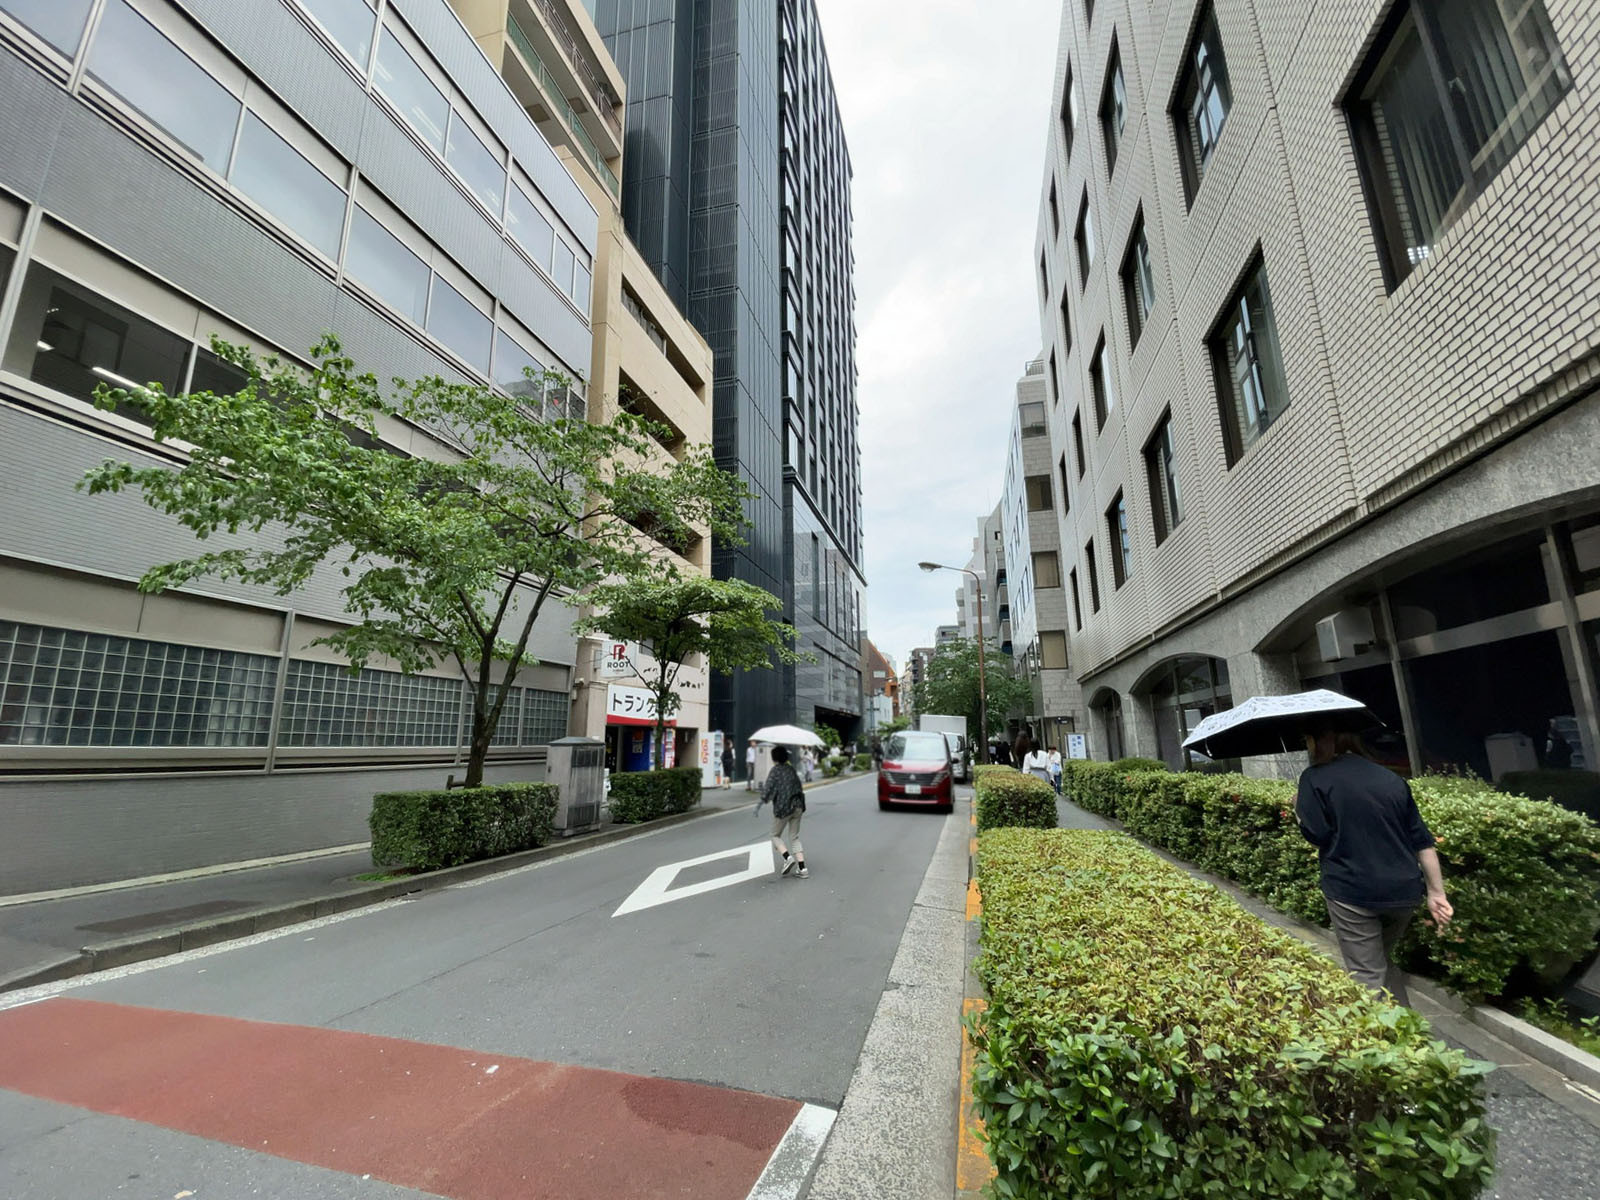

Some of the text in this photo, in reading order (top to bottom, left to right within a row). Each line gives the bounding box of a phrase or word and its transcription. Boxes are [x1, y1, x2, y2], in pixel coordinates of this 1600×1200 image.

[607, 661, 629, 669] ROOT
[613, 693, 668, 714] トランク
